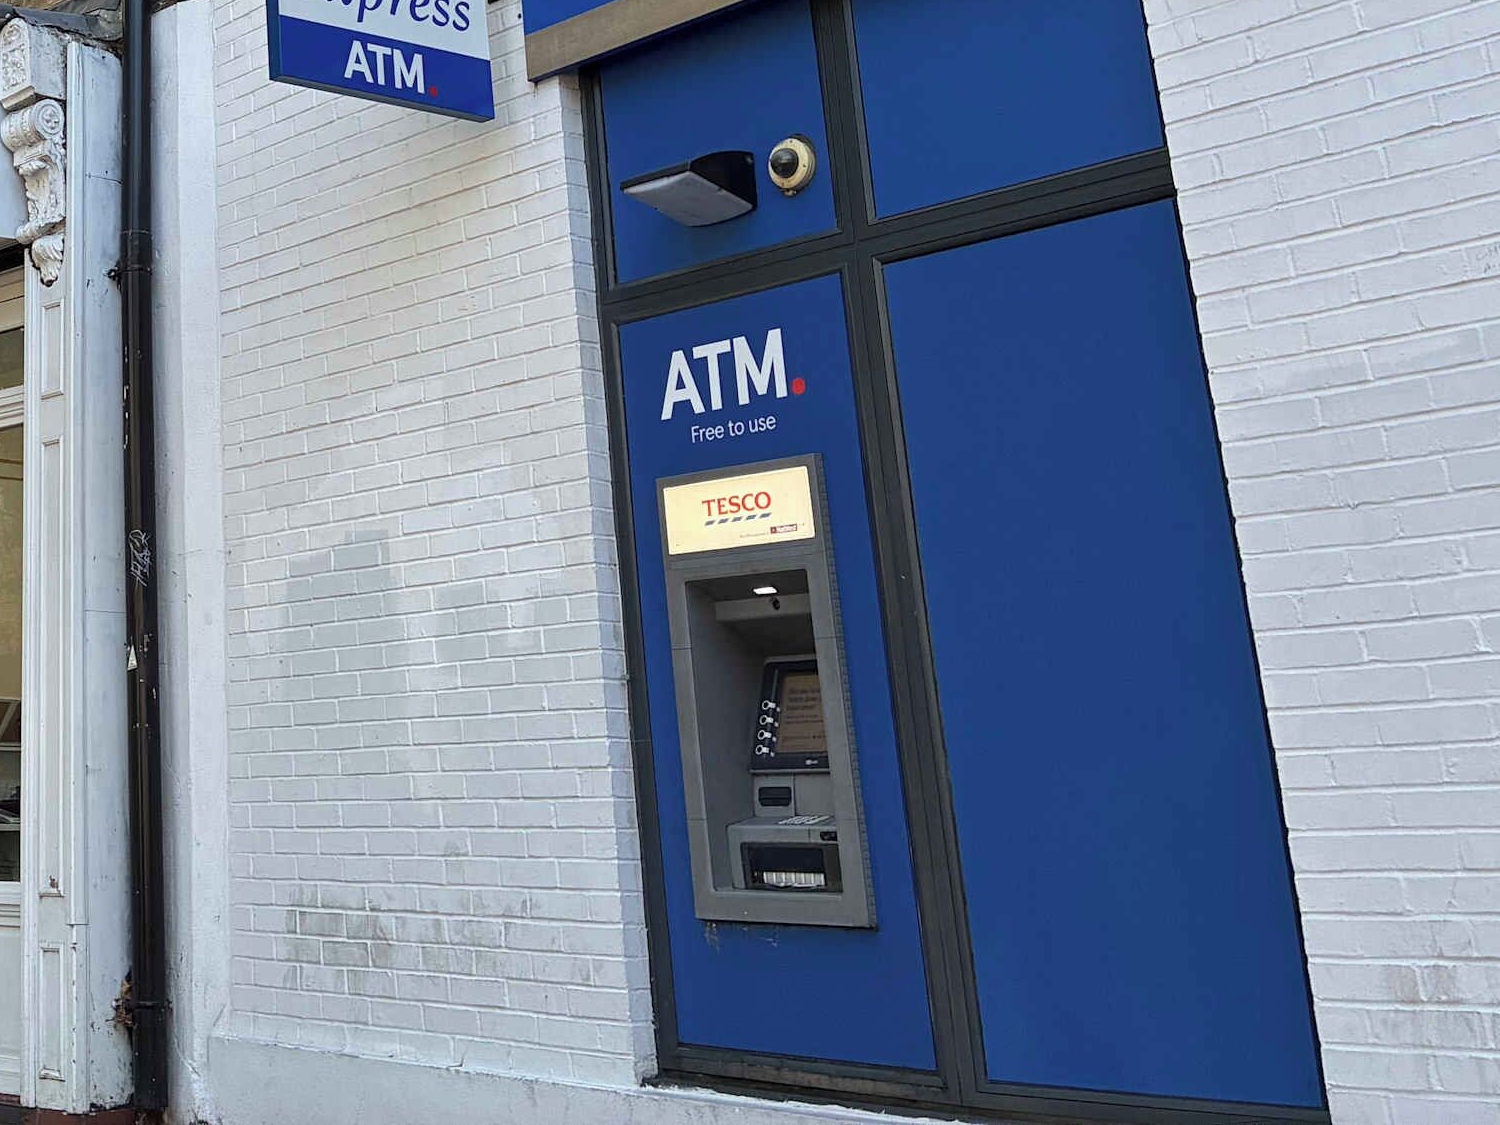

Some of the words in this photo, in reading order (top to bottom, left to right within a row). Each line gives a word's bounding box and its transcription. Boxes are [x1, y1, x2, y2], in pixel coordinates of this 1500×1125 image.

[691, 424, 724, 443] Free
[728, 419, 745, 437] to
[749, 415, 776, 432] use
[702, 491, 772, 517] TESCO
